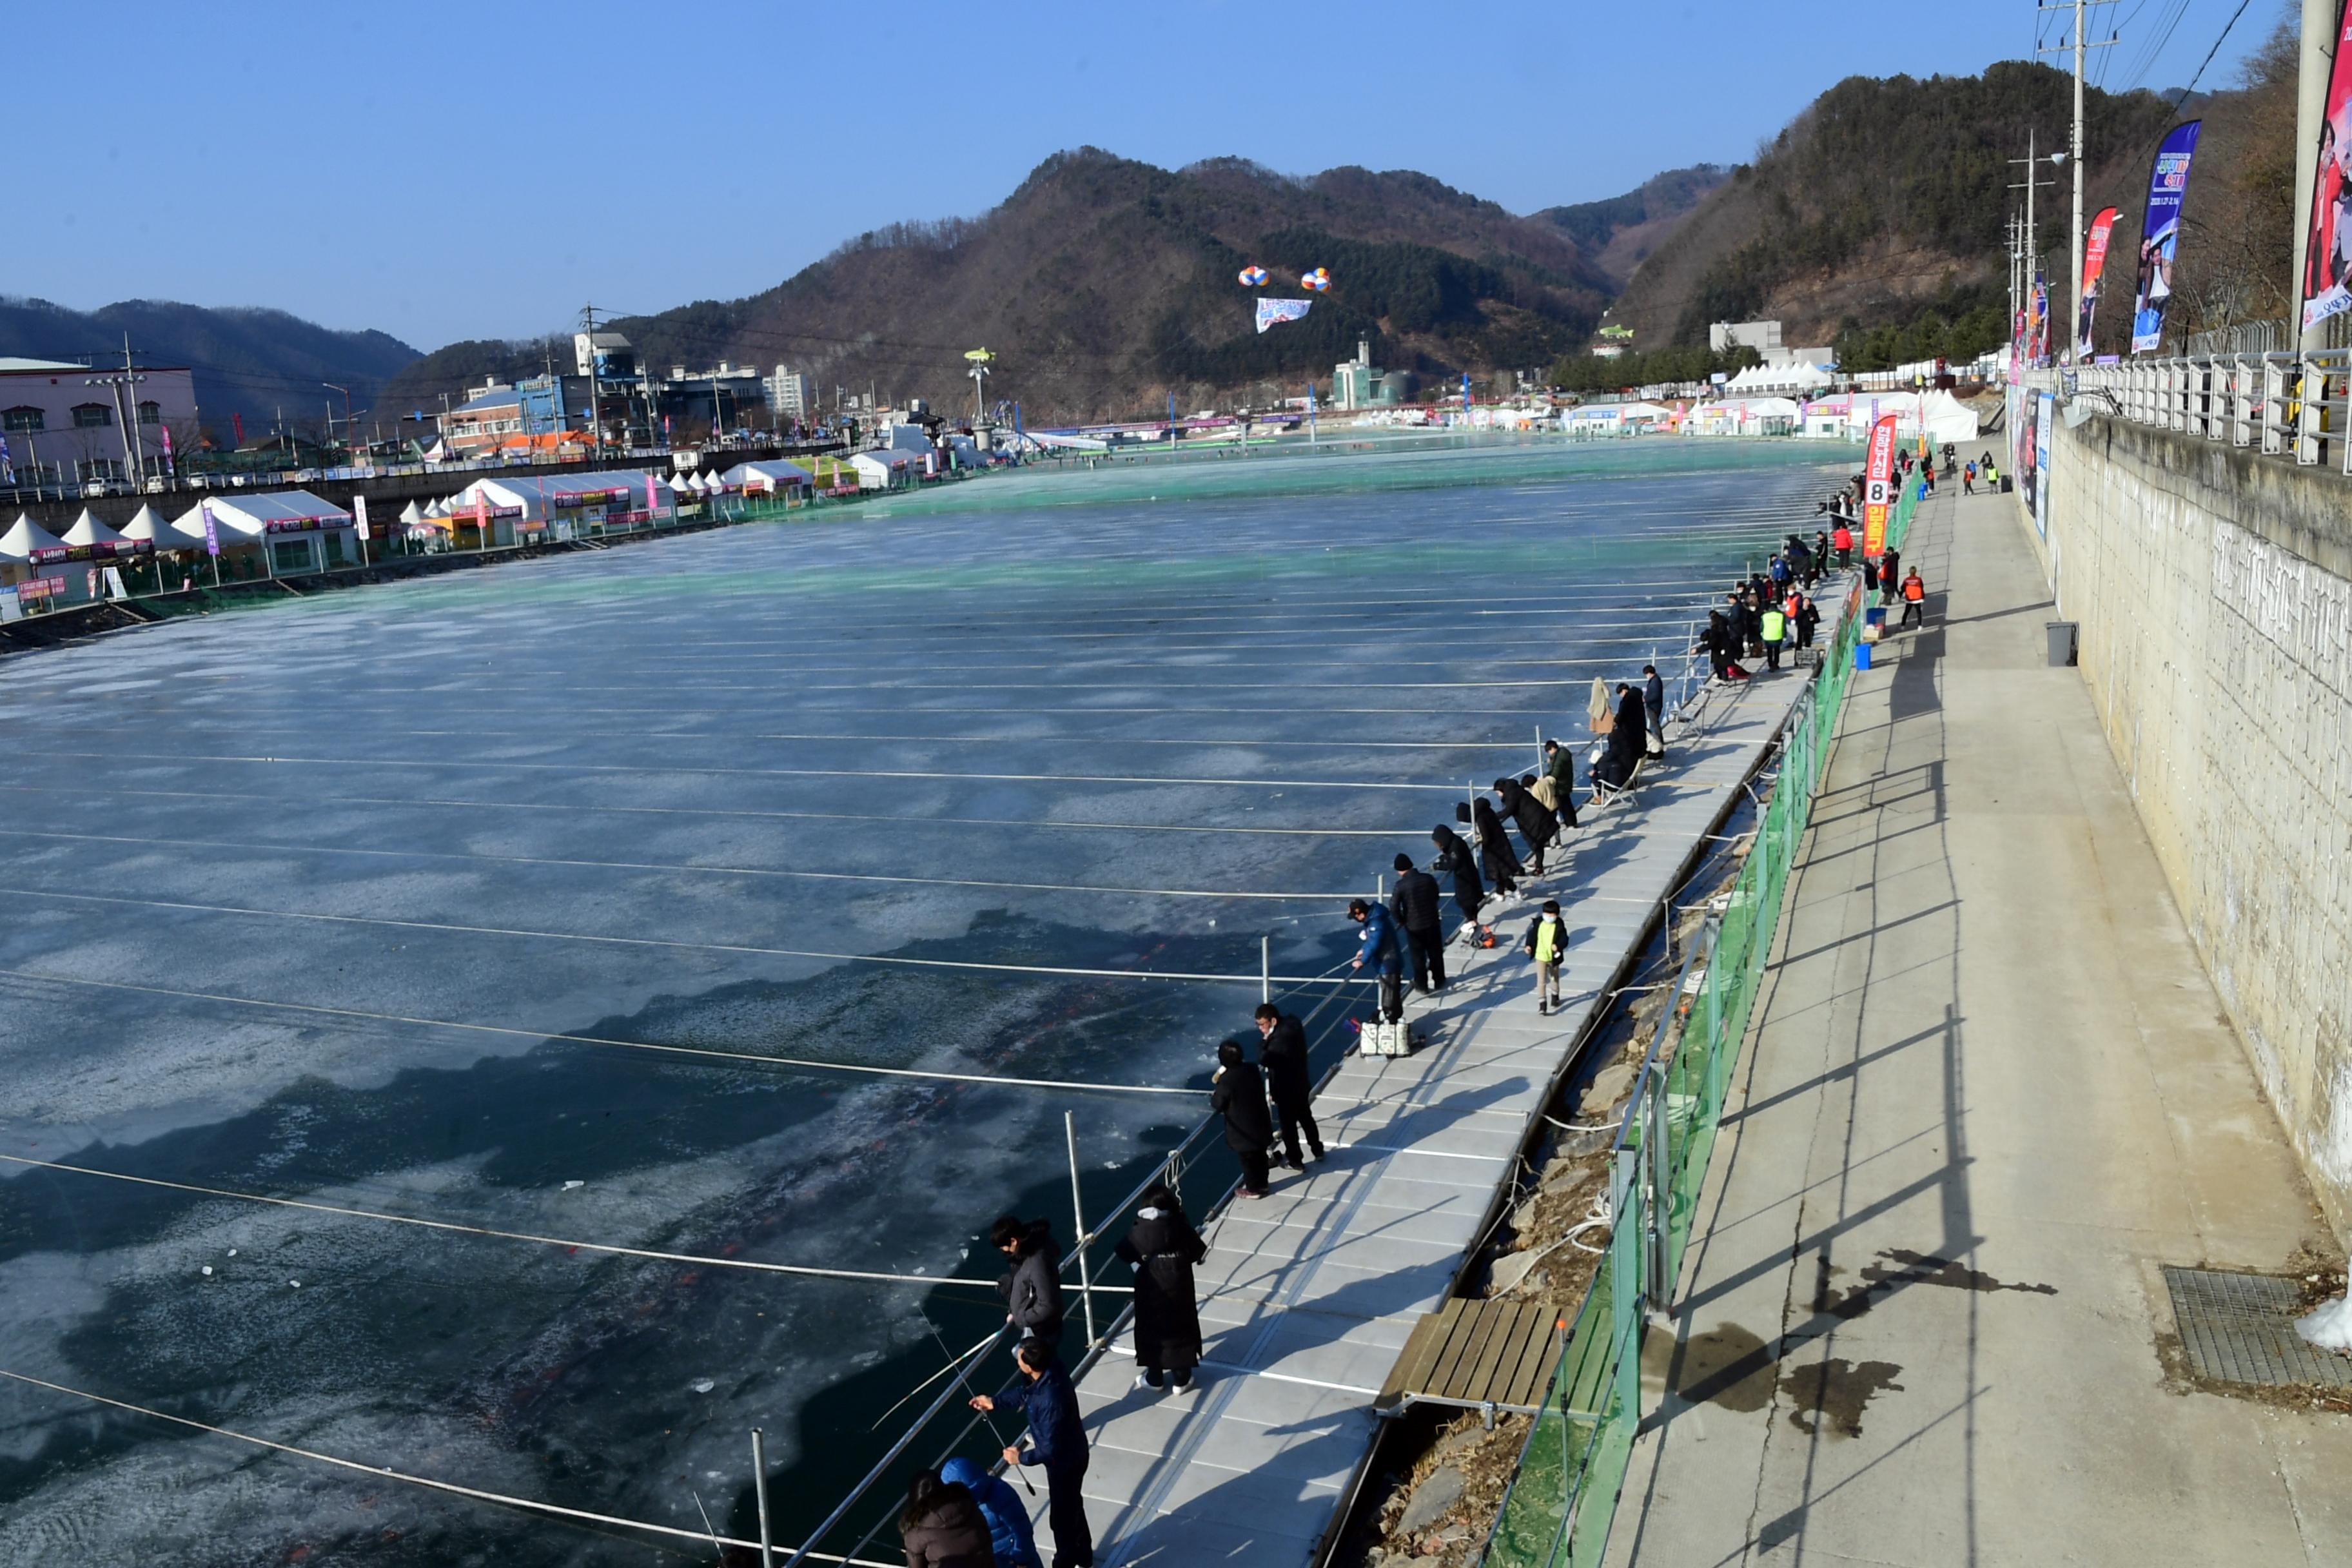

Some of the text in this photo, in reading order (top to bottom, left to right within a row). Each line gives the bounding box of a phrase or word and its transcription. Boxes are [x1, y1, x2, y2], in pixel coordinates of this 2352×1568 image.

[1872, 426, 1890, 478] 현장낚시터
[1871, 484, 1883, 500] 8
[1867, 505, 1885, 552] 입출구
